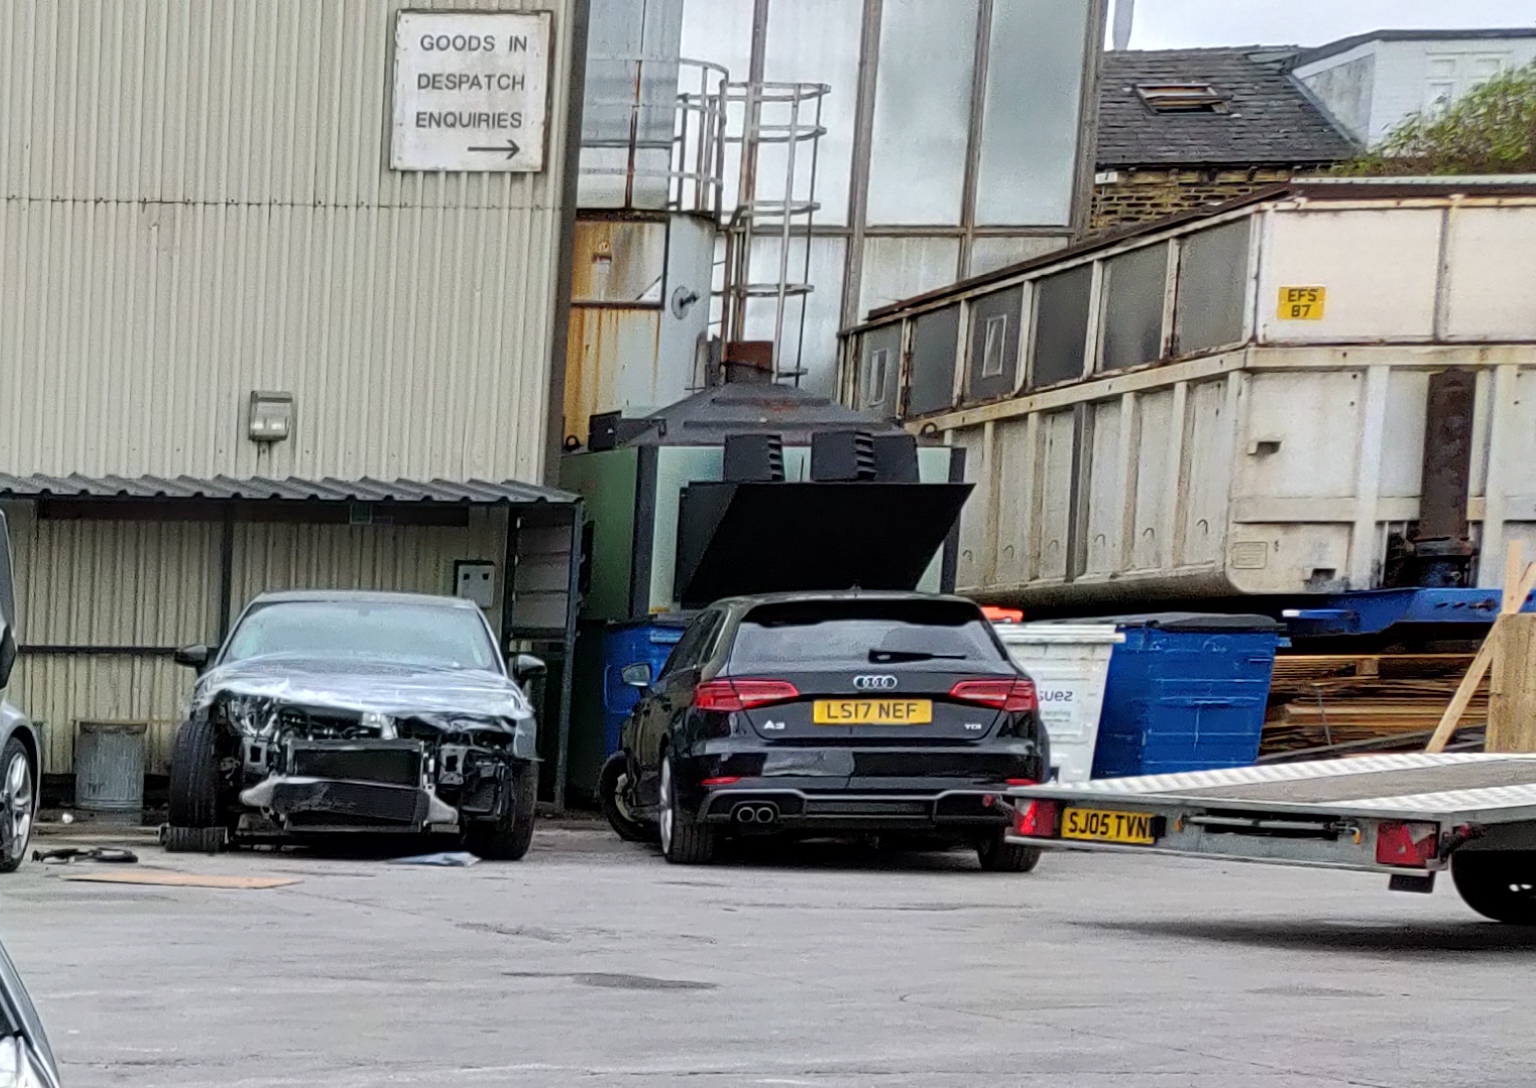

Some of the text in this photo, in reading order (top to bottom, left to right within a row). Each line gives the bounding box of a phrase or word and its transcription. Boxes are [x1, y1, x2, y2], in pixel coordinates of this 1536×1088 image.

[419, 34, 528, 53] GOODS IN
[416, 73, 526, 92] DESPATCH
[415, 111, 523, 130] ENQUIRIES
[1291, 304, 1312, 318] 87
[826, 702, 919, 719] LS17 NEF
[763, 719, 786, 730] A3
[1068, 811, 1147, 839] SJ05 TVN
